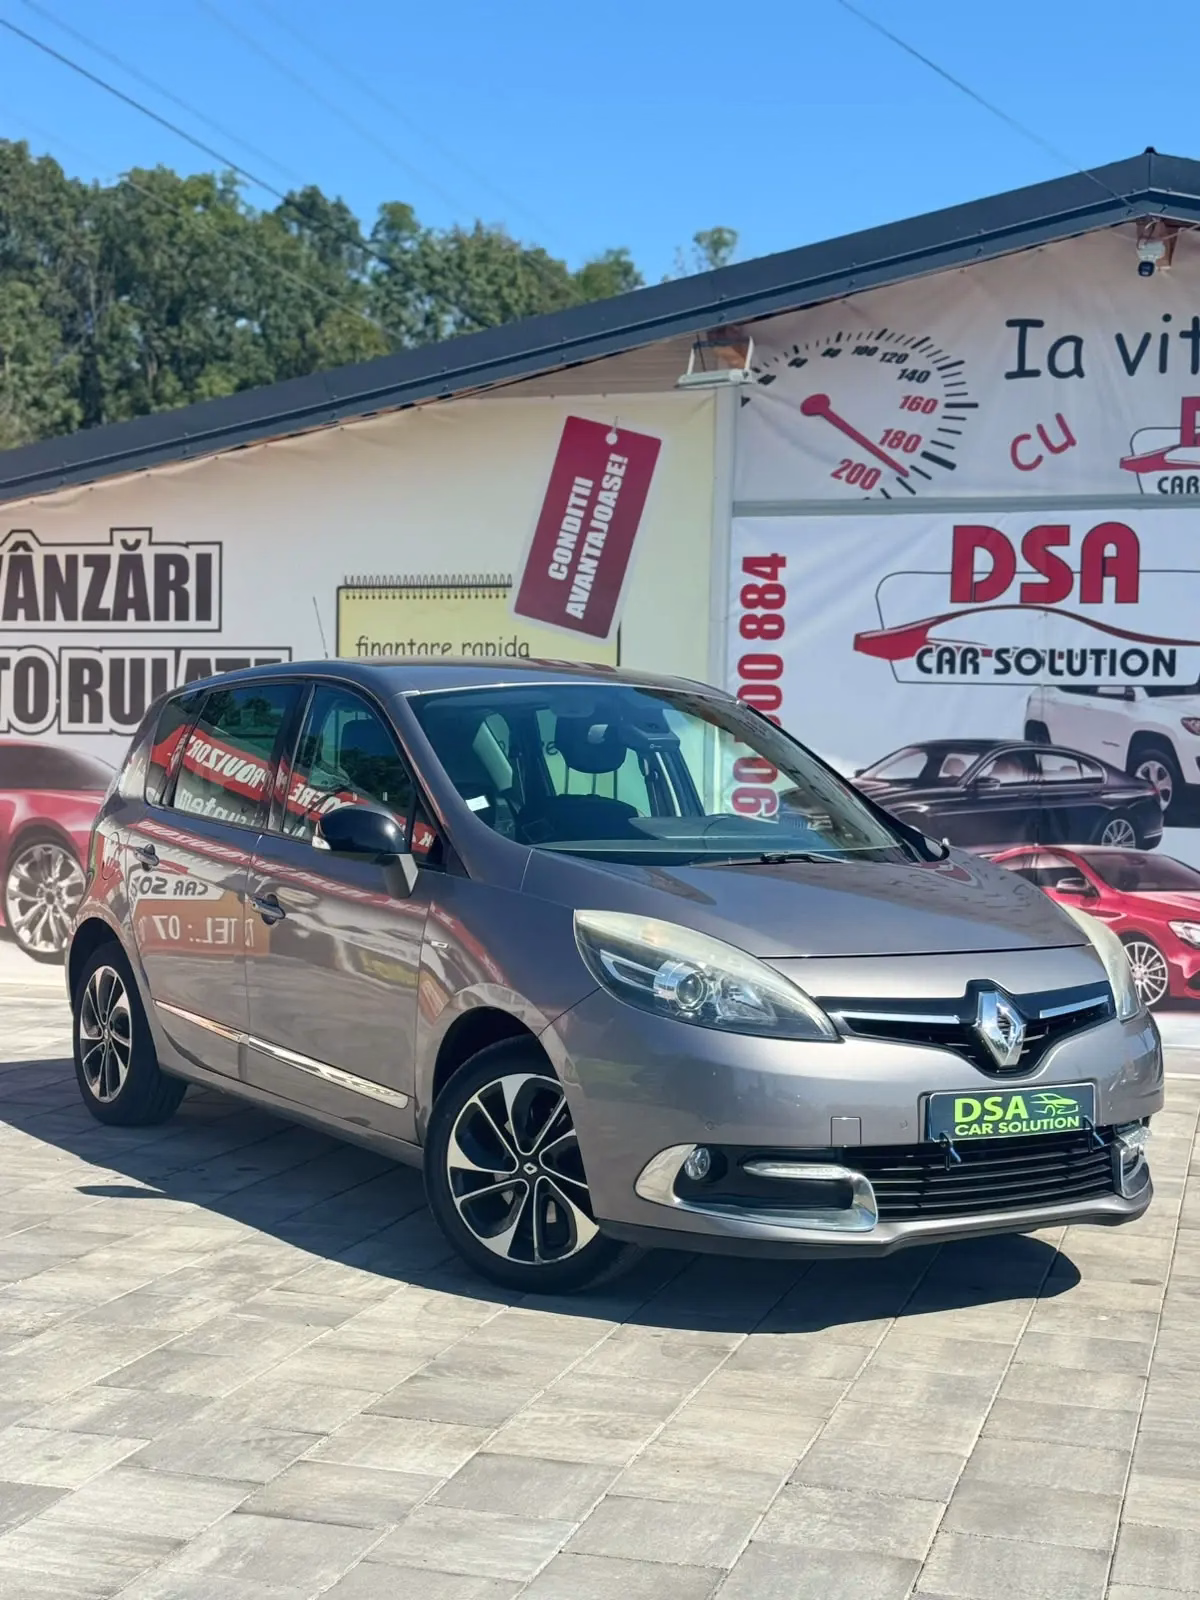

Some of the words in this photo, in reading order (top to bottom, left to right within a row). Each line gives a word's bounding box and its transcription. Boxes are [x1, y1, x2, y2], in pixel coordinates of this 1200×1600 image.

[879, 351, 910, 365] 120
[1004, 318, 1085, 380] Ia
[1114, 313, 1200, 377] vit
[897, 368, 932, 384] 140
[898, 394, 940, 415] 160
[878, 428, 923, 454] 180
[1010, 412, 1078, 472] cu
[830, 458, 882, 491] 200
[548, 476, 594, 581] CONDITII
[565, 453, 630, 620] AVANTAJOASE!
[0, 539, 212, 622] ÂNZĂRI
[950, 521, 1140, 604] DSA
[738, 552, 788, 641] 884
[916, 646, 980, 676] CAR
[994, 647, 1177, 678] SOLUTION
[734, 653, 785, 742] 00
[954, 1094, 1030, 1123] DSA
[955, 1122, 994, 1136] CAR
[998, 1115, 1081, 1135] SOLUTION
